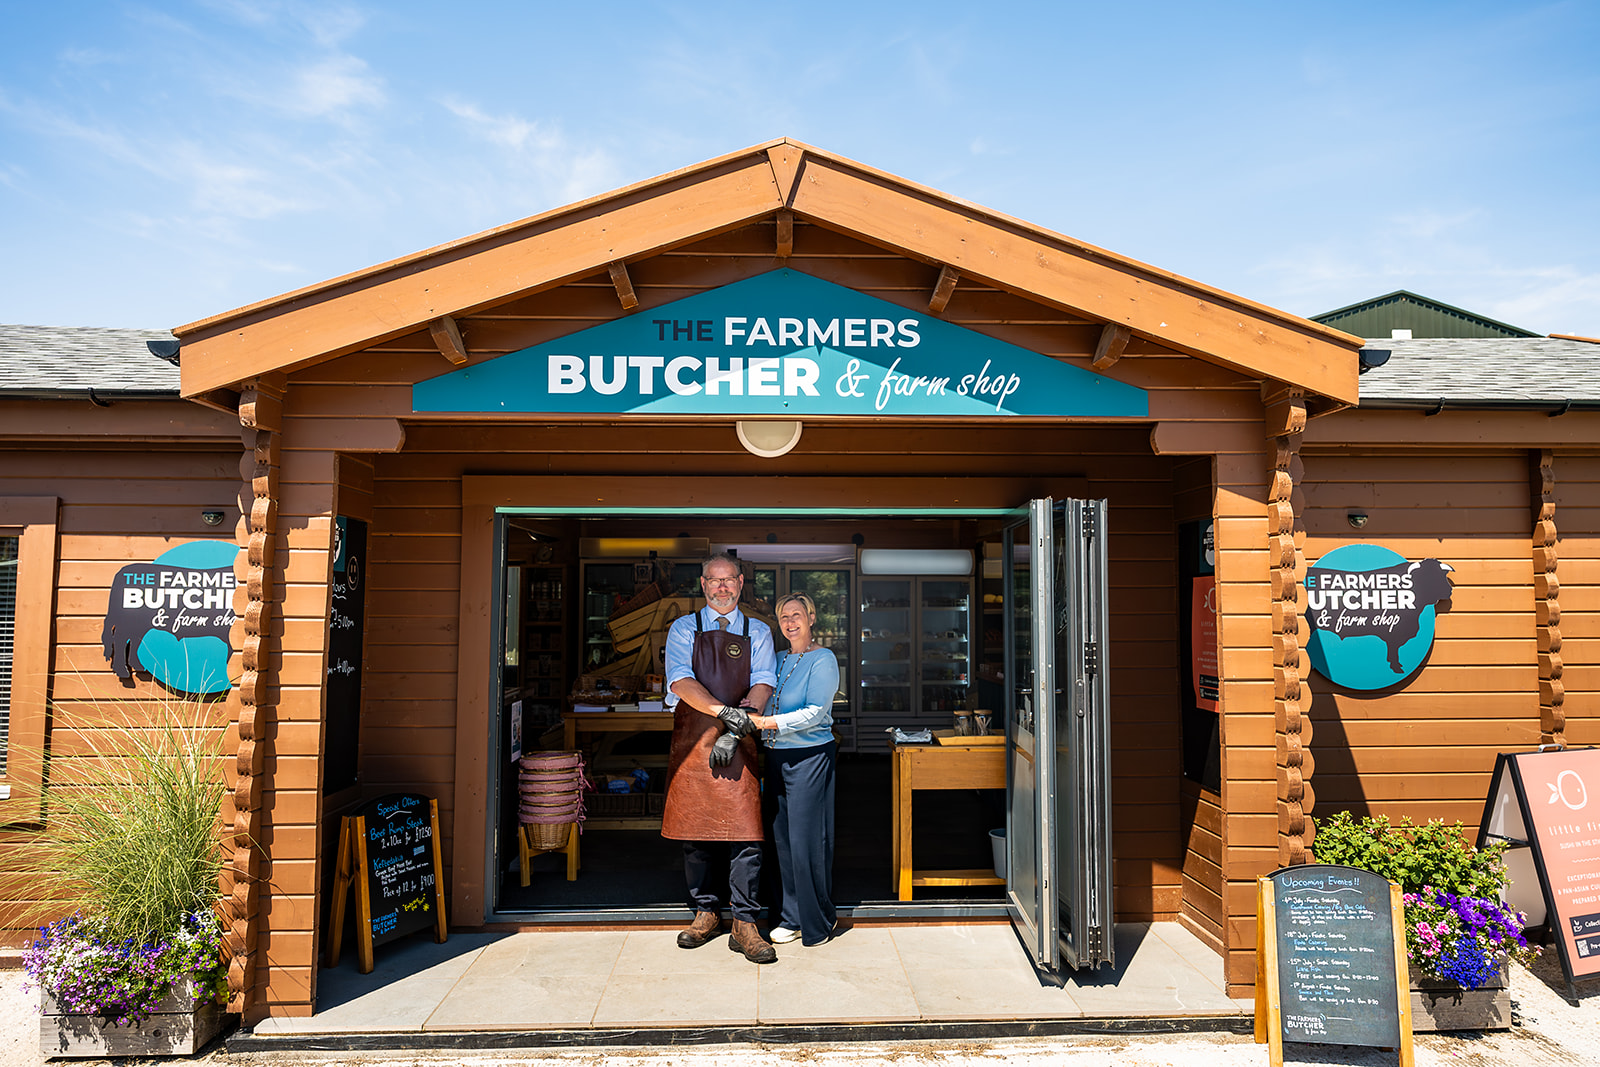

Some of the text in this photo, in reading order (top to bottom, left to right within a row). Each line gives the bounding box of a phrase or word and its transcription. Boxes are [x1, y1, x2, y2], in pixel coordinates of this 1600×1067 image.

[652, 316, 921, 348] THE FARMERS
[547, 355, 1021, 412] BUTCHER & farm shop
[123, 571, 238, 588] THE FARME
[1320, 574, 1414, 590] FARMERS
[123, 587, 235, 610] BUTCH
[1308, 589, 1417, 611] UTCHER
[152, 608, 236, 633] & farm sho
[1316, 608, 1400, 633] & farm shop
[377, 803, 400, 817] Special
[1548, 824, 1581, 836] little
[1282, 876, 1325, 890] Upcoming
[1287, 1021, 1325, 1030] BUTCHER
